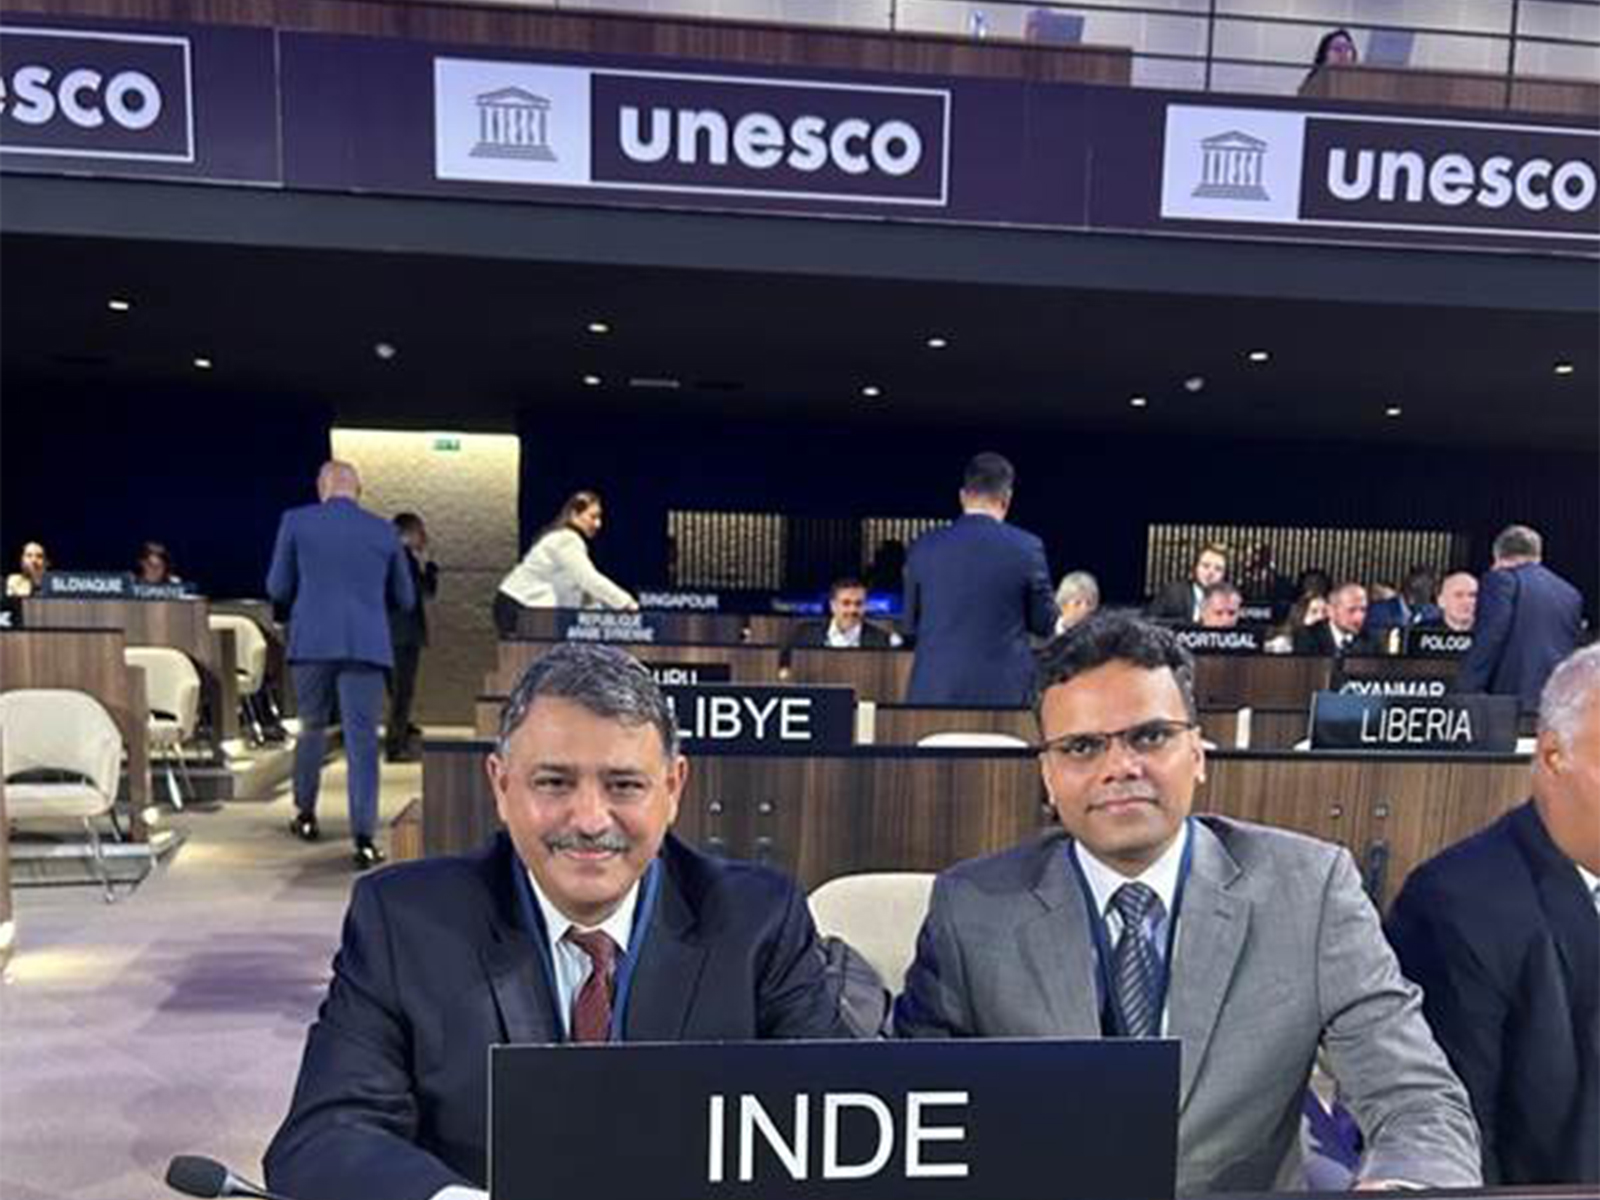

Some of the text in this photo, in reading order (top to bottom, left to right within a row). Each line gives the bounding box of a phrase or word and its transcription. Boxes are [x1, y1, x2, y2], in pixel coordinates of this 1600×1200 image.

[0, 66, 162, 129] sco
[619, 105, 922, 175] unesco
[1327, 148, 1597, 211] unesco
[639, 593, 719, 609] SINGAPOUR
[1176, 631, 1258, 649] PORTUGAL
[1420, 634, 1473, 651] POLOG
[653, 668, 699, 686] URU
[665, 696, 813, 740] LIBYE
[1360, 706, 1473, 743] LIBERIA
[708, 1091, 970, 1183] INDE
